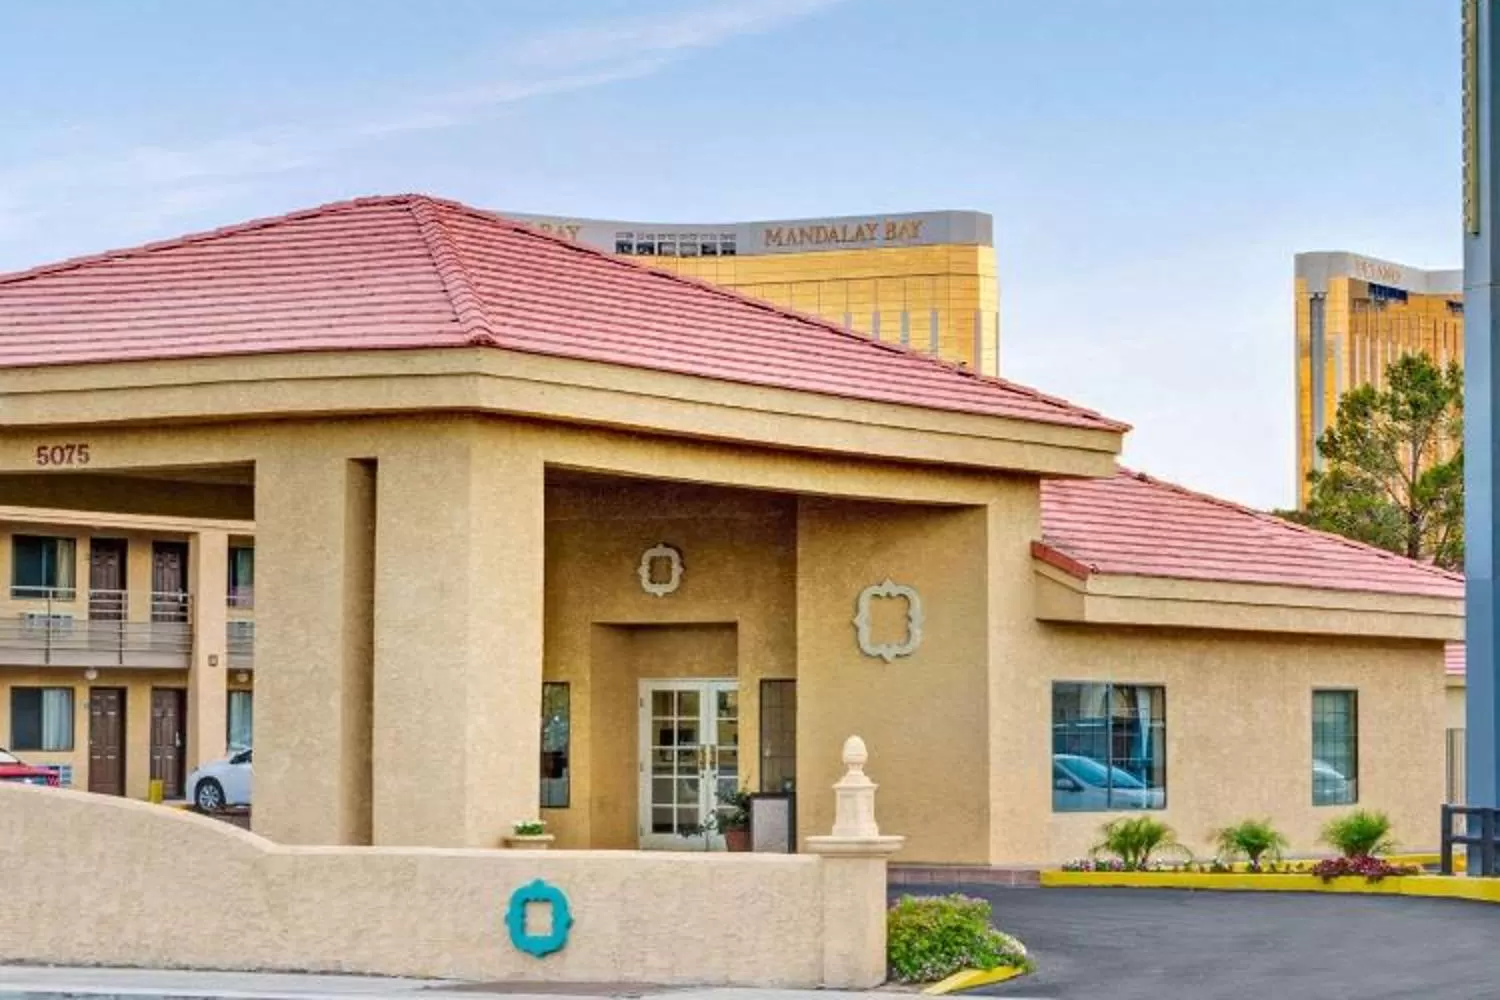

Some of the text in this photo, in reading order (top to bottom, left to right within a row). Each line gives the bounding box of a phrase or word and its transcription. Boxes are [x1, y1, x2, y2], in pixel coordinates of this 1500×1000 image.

[764, 218, 924, 248] MANDALAY BAY
[36, 443, 91, 466] 5075
